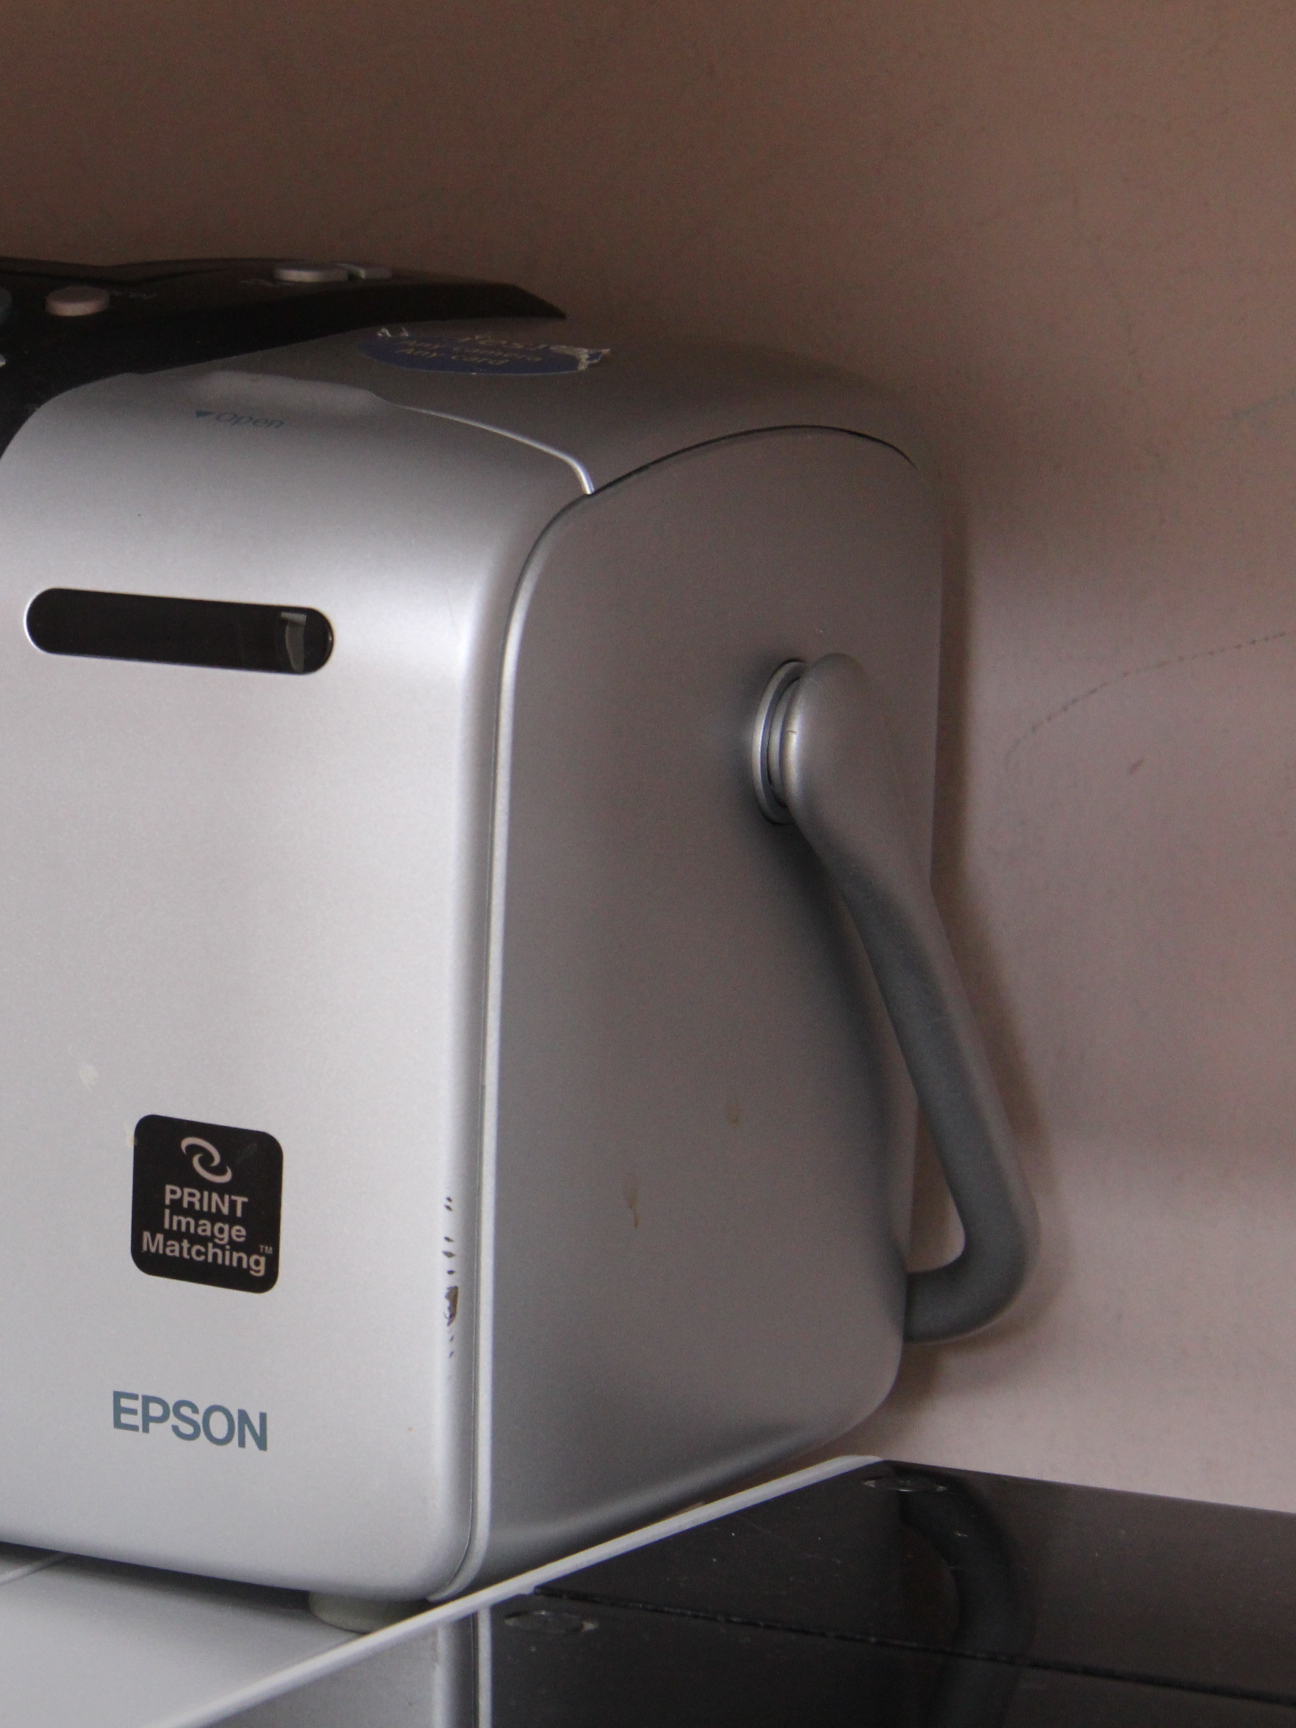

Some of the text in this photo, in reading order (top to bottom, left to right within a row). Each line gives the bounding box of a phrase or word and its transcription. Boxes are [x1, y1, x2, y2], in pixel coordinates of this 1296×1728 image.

[216, 411, 284, 429] Open
[164, 1184, 248, 1218] PRINT
[163, 1209, 246, 1243] Image
[113, 1391, 267, 1452] EPSON
